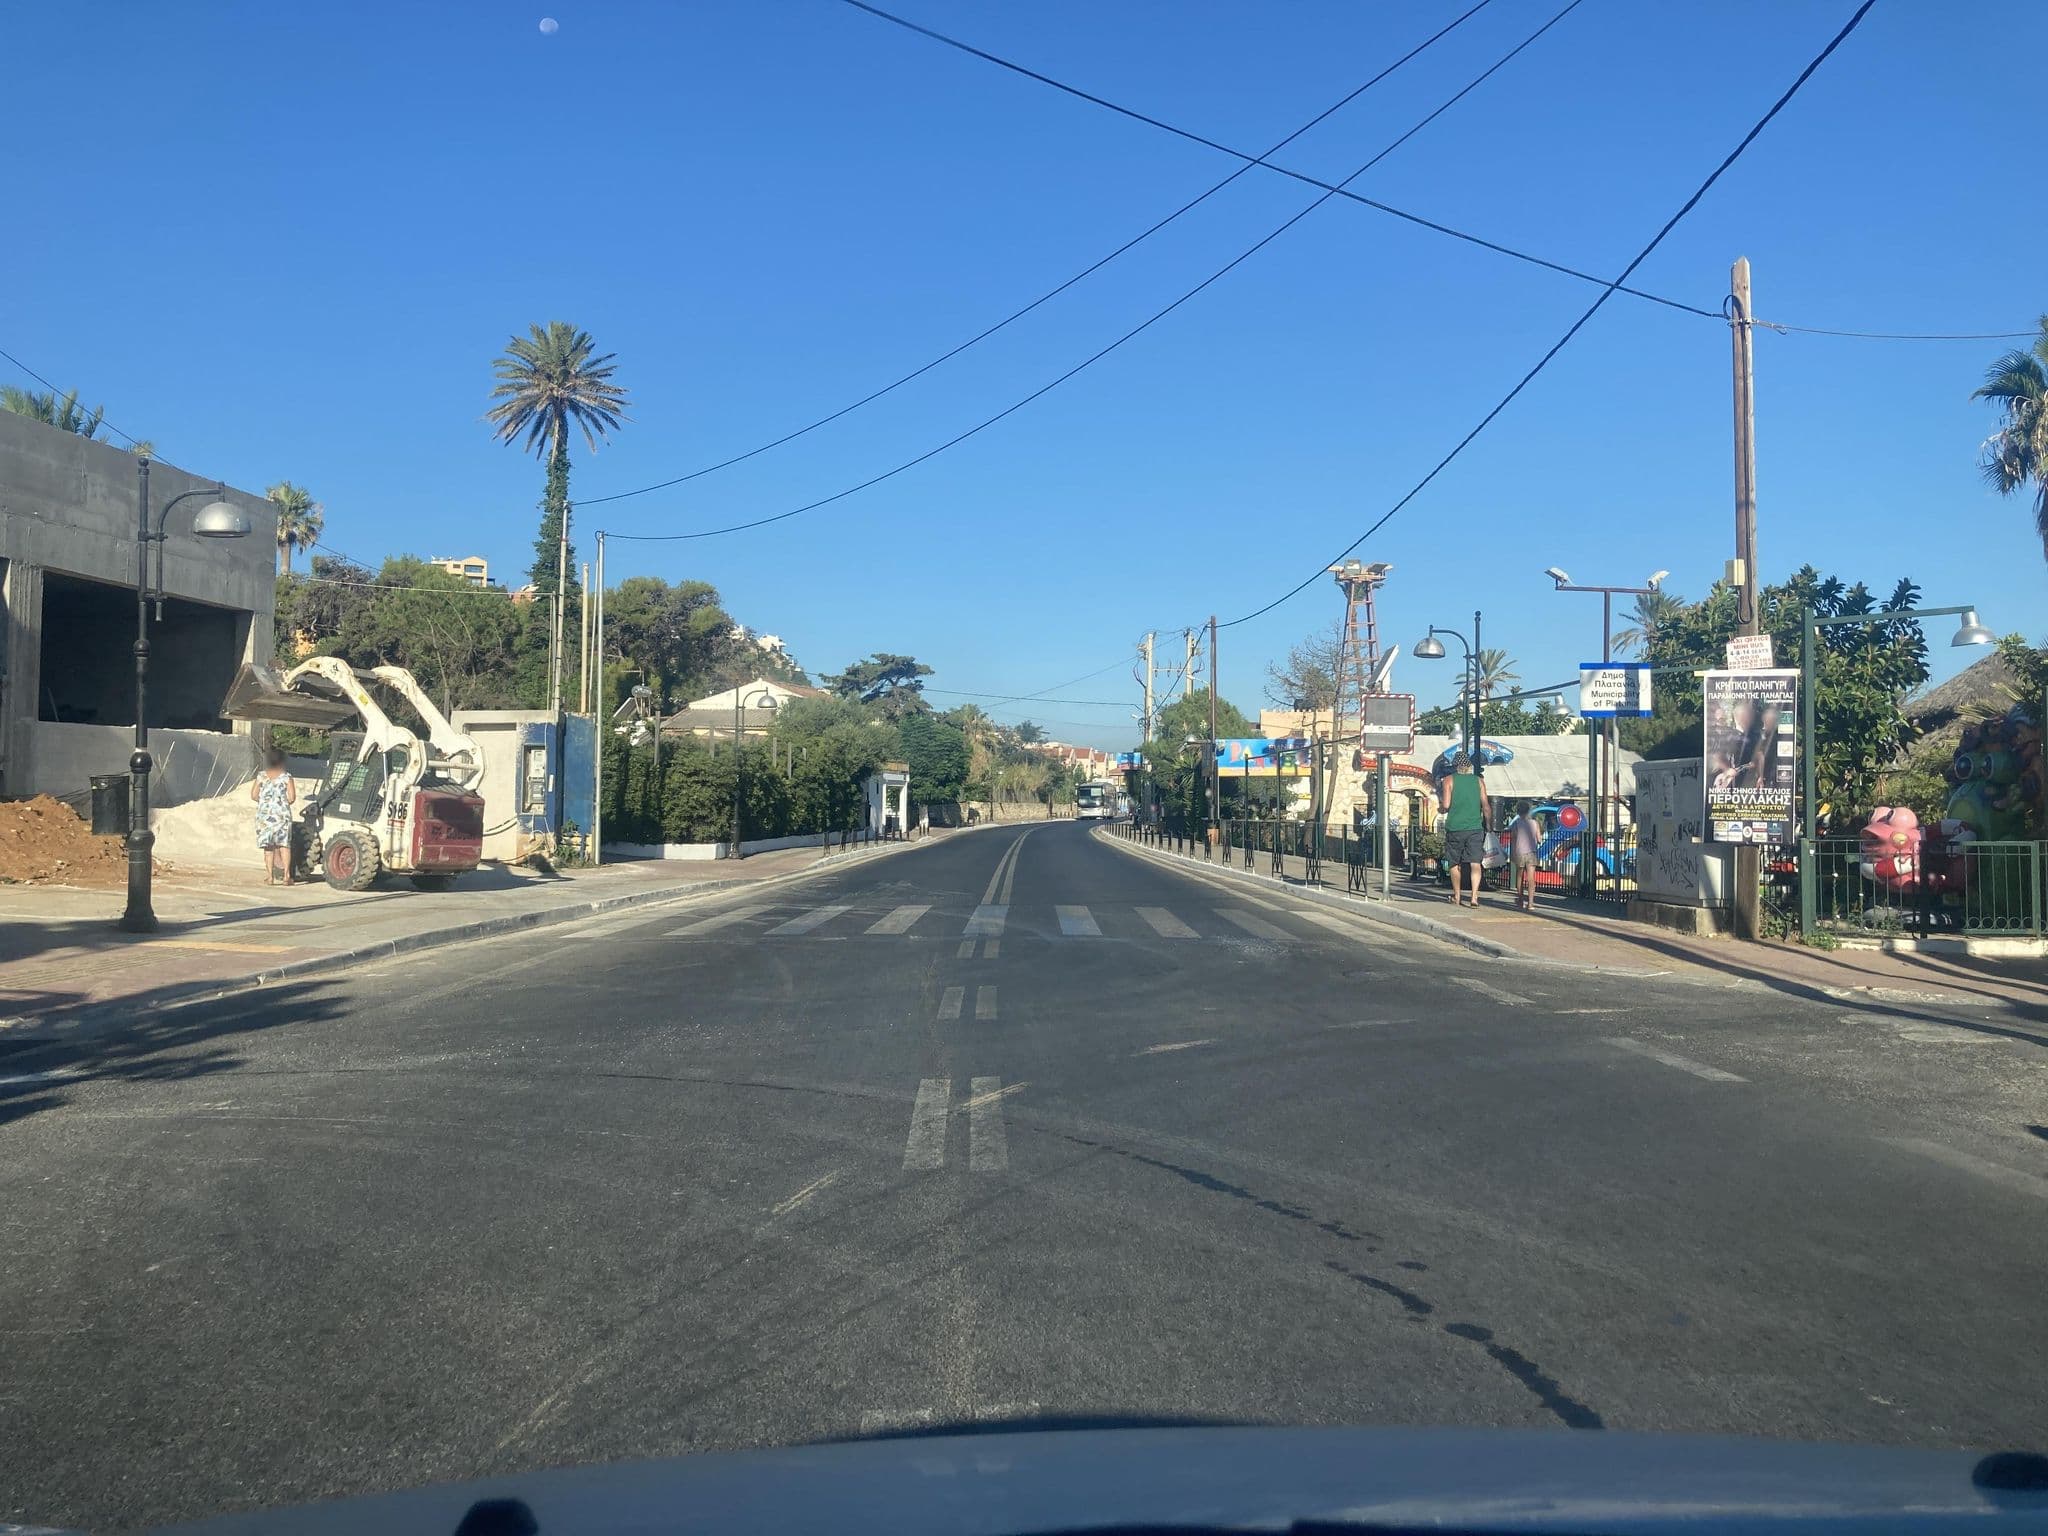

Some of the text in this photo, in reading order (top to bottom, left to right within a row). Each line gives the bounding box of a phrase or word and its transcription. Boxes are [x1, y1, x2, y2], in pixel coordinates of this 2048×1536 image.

[1715, 681, 1787, 690] ΚΡΗΤΙΚΟ ΠΑΝΗΓΥΡΙ
[1591, 690, 1640, 699] Municipality
[1708, 692, 1746, 700] ΠΑΡΑΜΟΝΗ
[1708, 794, 1792, 805] ΠΕΡΟΥΛΑΚΗΣ
